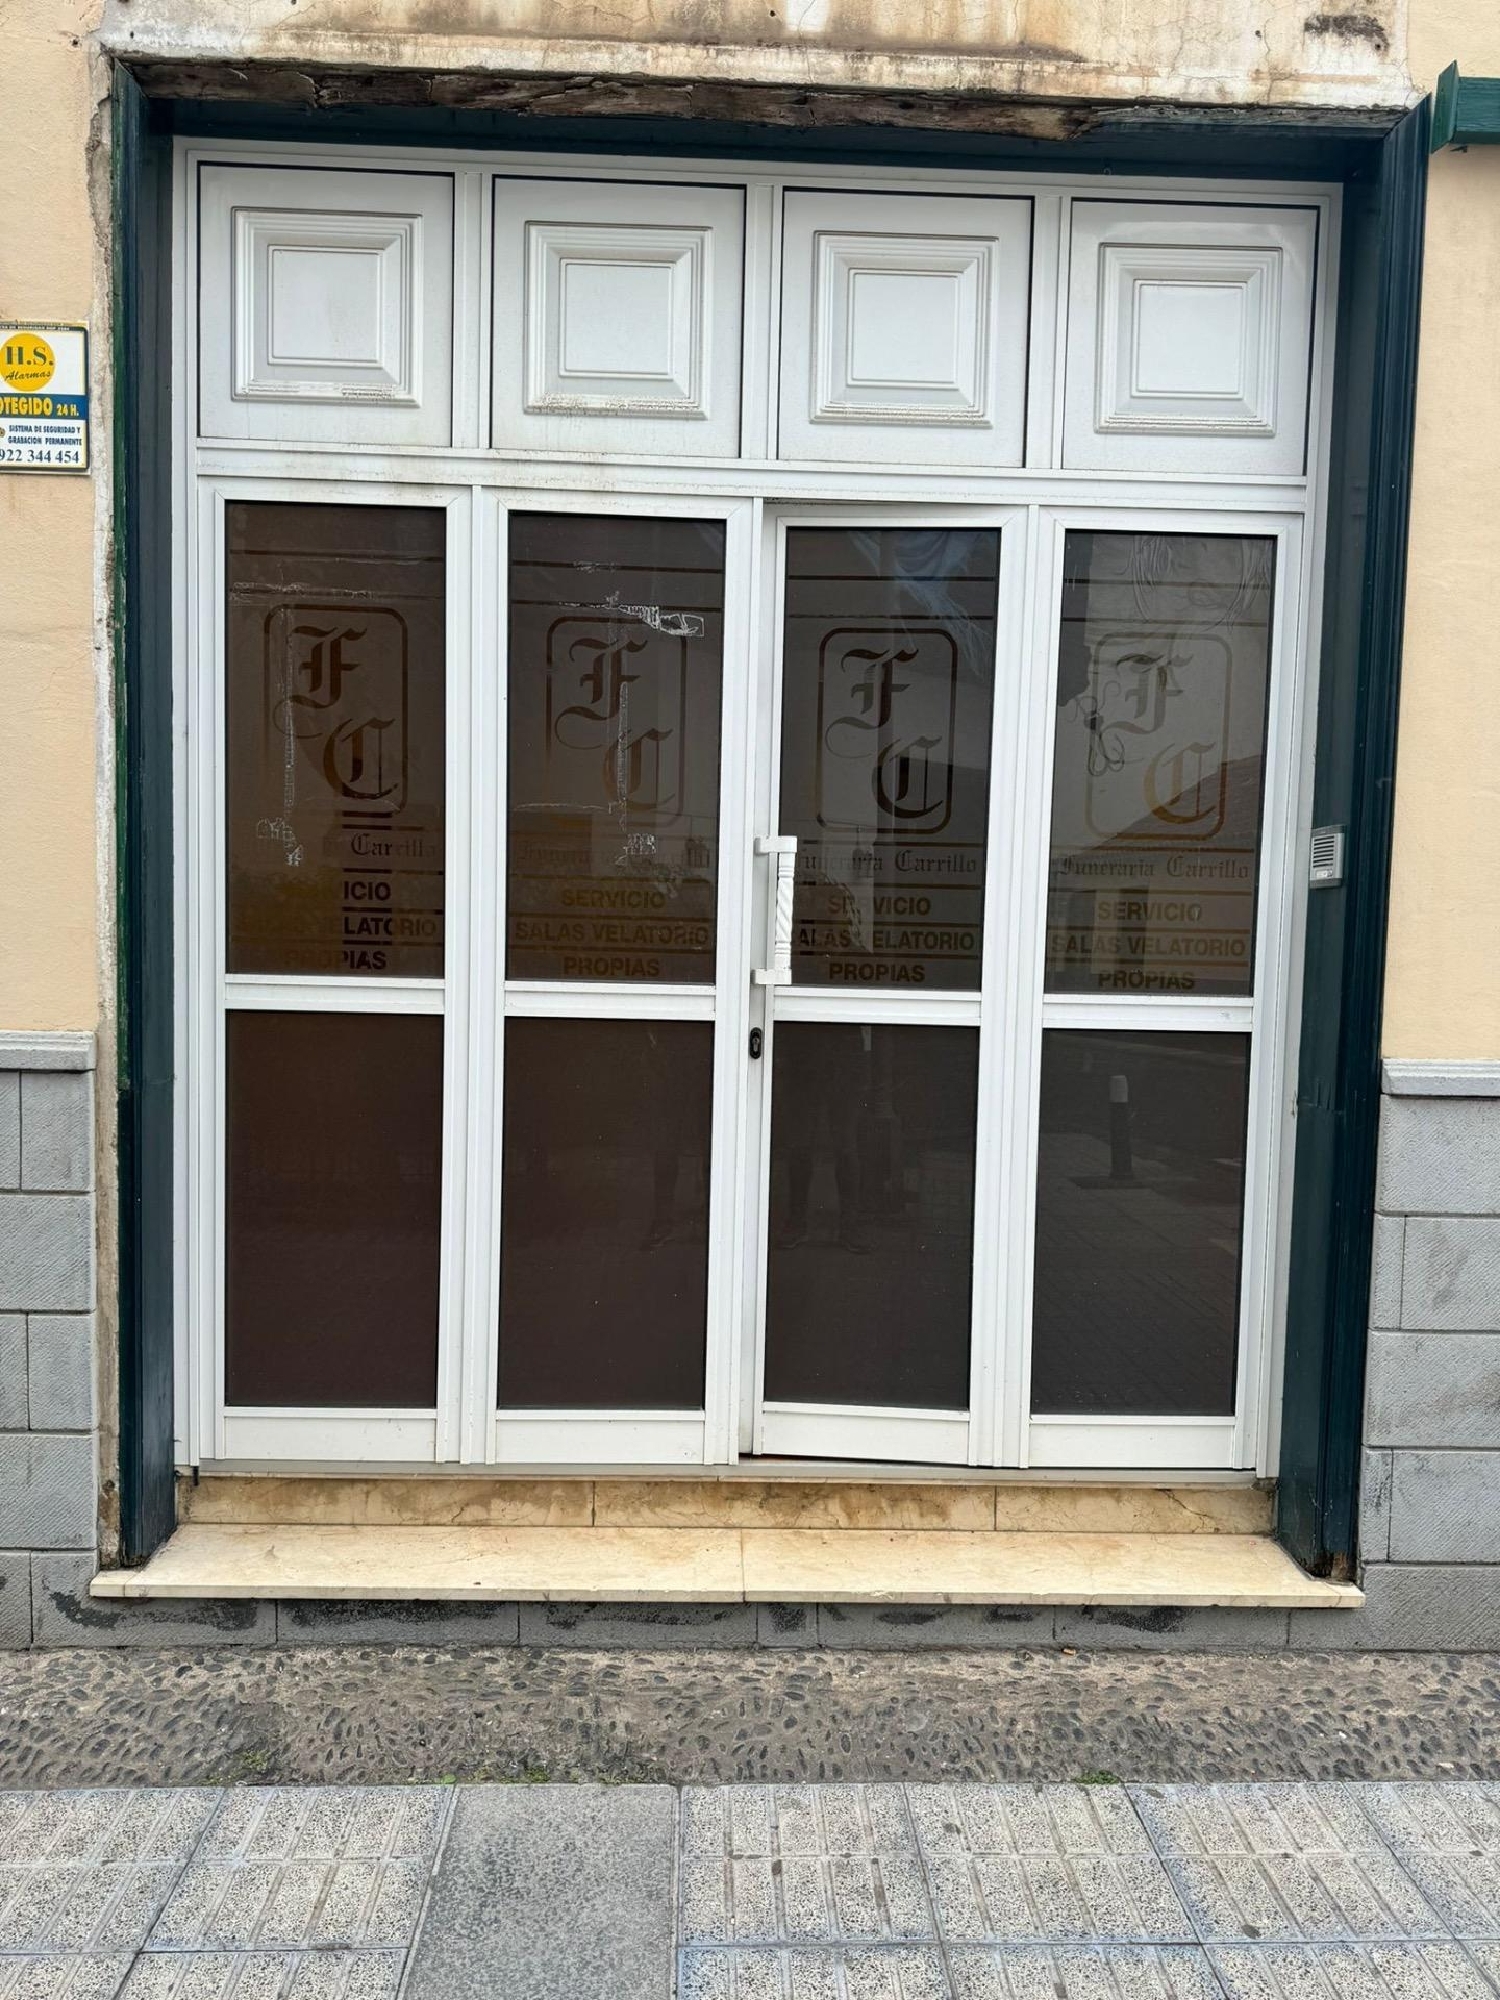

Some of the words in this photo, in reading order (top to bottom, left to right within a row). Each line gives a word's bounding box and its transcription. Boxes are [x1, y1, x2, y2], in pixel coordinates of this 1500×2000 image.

[5, 370, 51, 381] Alarmas
[57, 404, 68, 416] 24
[9, 425, 33, 433] SISTEMA
[34, 425, 42, 433] DE
[43, 425, 76, 434] SEGURIDAD
[45, 438, 82, 446] PERMANENTE
[0, 448, 23, 461] 922
[27, 449, 51, 463] 344
[55, 450, 79, 463] 454
[894, 849, 977, 873] Carrillo
[1166, 854, 1249, 879] Carrillo
[561, 888, 667, 909] SERVICIO
[828, 895, 931, 916] SVICIO
[1097, 901, 1203, 922] SERVICIO
[516, 921, 584, 942] SALAS
[592, 924, 709, 945] VELATORIO
[799, 928, 850, 948] ALAS
[873, 930, 975, 950] ELATORIO
[1051, 934, 1119, 954] SALAS
[1127, 935, 1246, 957] VELATORIO
[563, 956, 660, 977] PROPIAS
[828, 962, 926, 983] PROPIAS
[1098, 969, 1196, 990] PROPIAS
